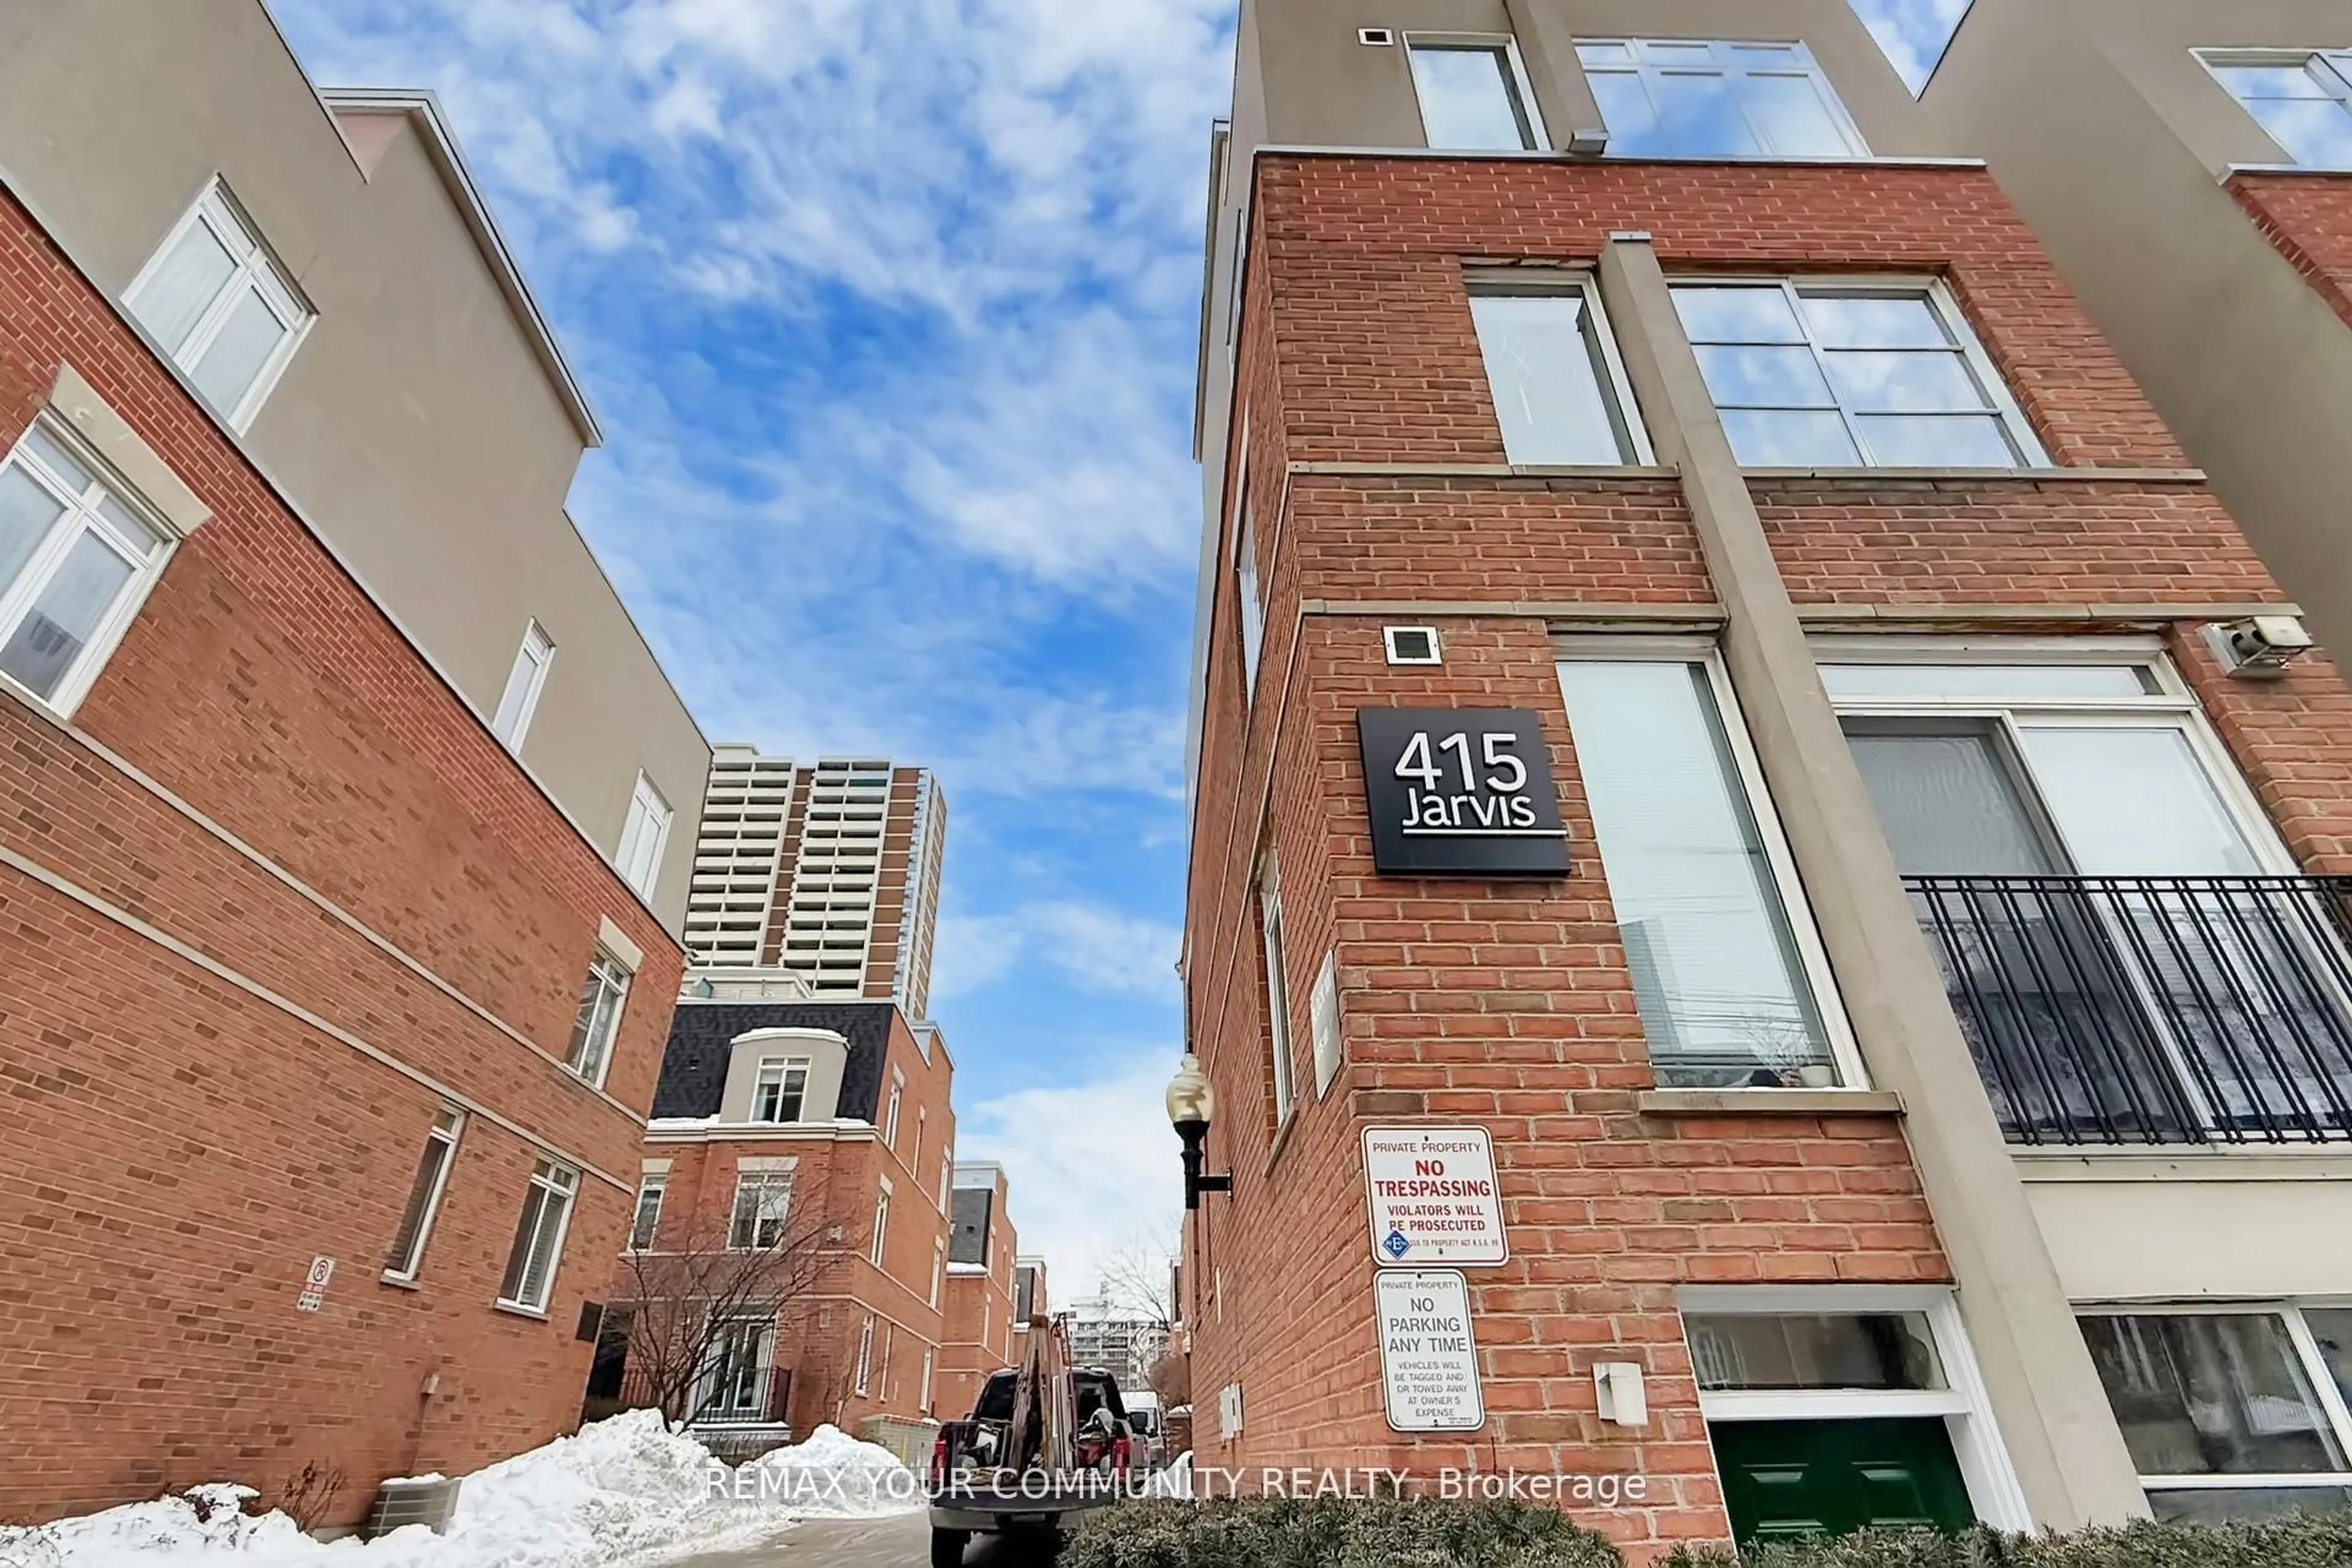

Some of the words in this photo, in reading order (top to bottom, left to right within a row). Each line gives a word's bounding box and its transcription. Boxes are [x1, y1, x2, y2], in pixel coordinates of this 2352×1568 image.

[1395, 732, 1528, 792] 415
[1402, 788, 1536, 826] Jarvis
[1373, 1143, 1416, 1152] PRIVATE
[1422, 1143, 1481, 1152] PROPERTY
[1415, 1160, 1444, 1176] NO
[1375, 1181, 1490, 1196] TRESPASSING
[1387, 1205, 1451, 1216] VIOLATORS
[1455, 1205, 1483, 1215] WILL
[1409, 1220, 1485, 1231] PROSECUTED
[1411, 1298, 1434, 1311] NO
[1390, 1318, 1460, 1332] PARKING
[1389, 1338, 1420, 1352] ANY
[1428, 1338, 1468, 1352] TIME
[1415, 1408, 1455, 1417] EXPENSE
